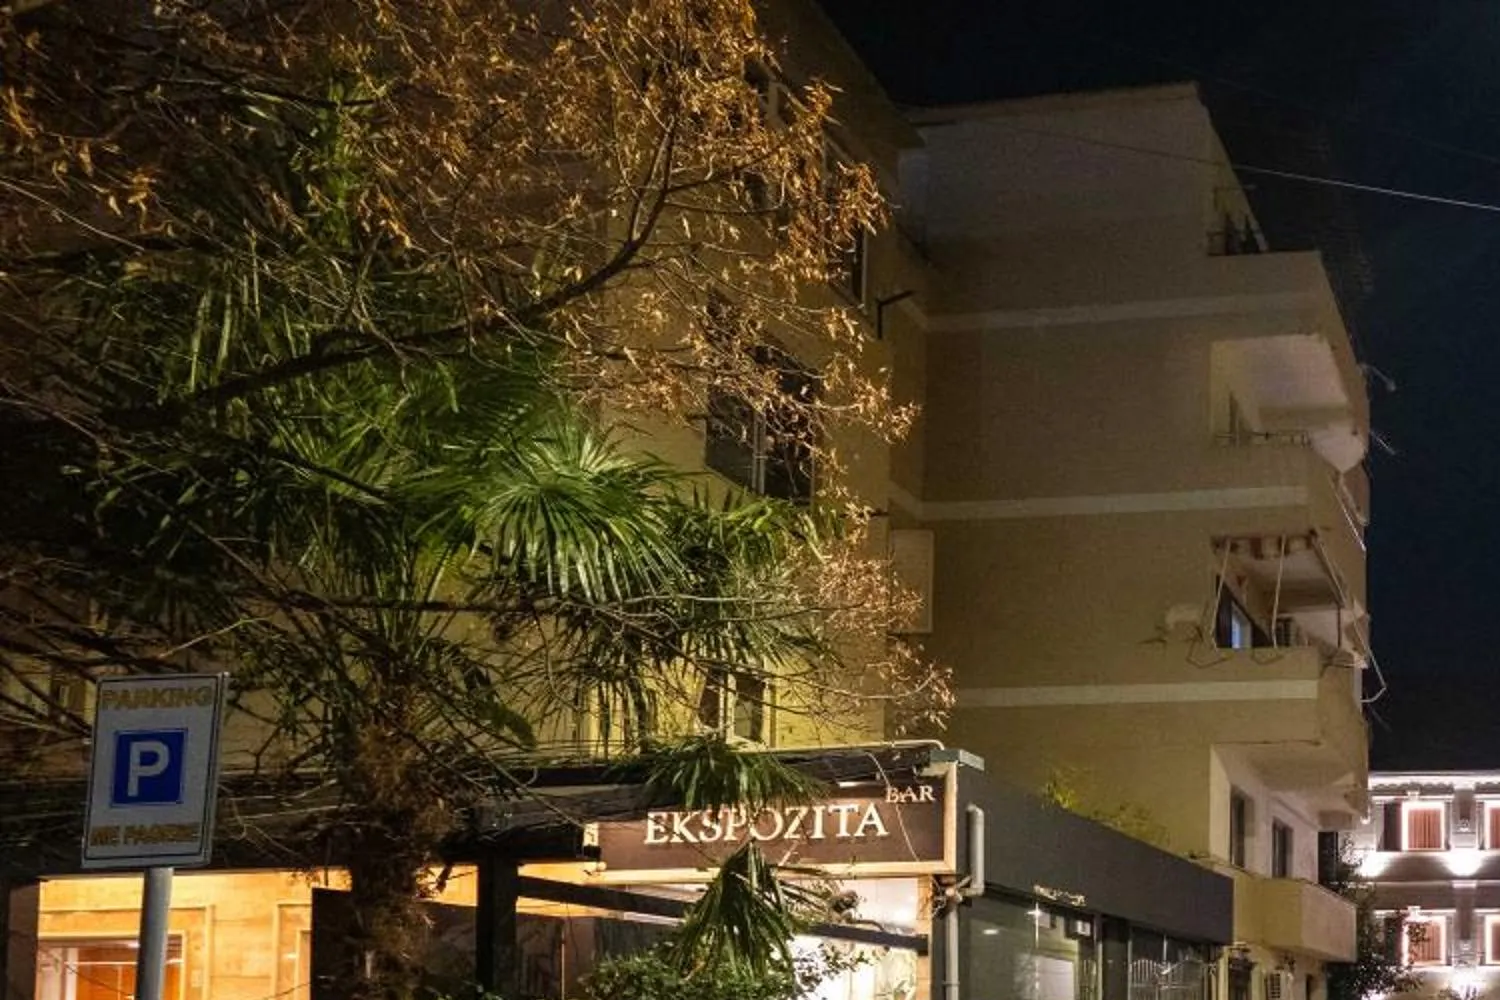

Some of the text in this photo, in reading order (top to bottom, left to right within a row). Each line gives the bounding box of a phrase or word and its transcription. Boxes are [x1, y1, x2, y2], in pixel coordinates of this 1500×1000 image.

[101, 686, 213, 710] PARKING
[127, 740, 170, 797] P
[884, 785, 937, 804] BAR
[643, 803, 890, 844] EKSPOZITA
